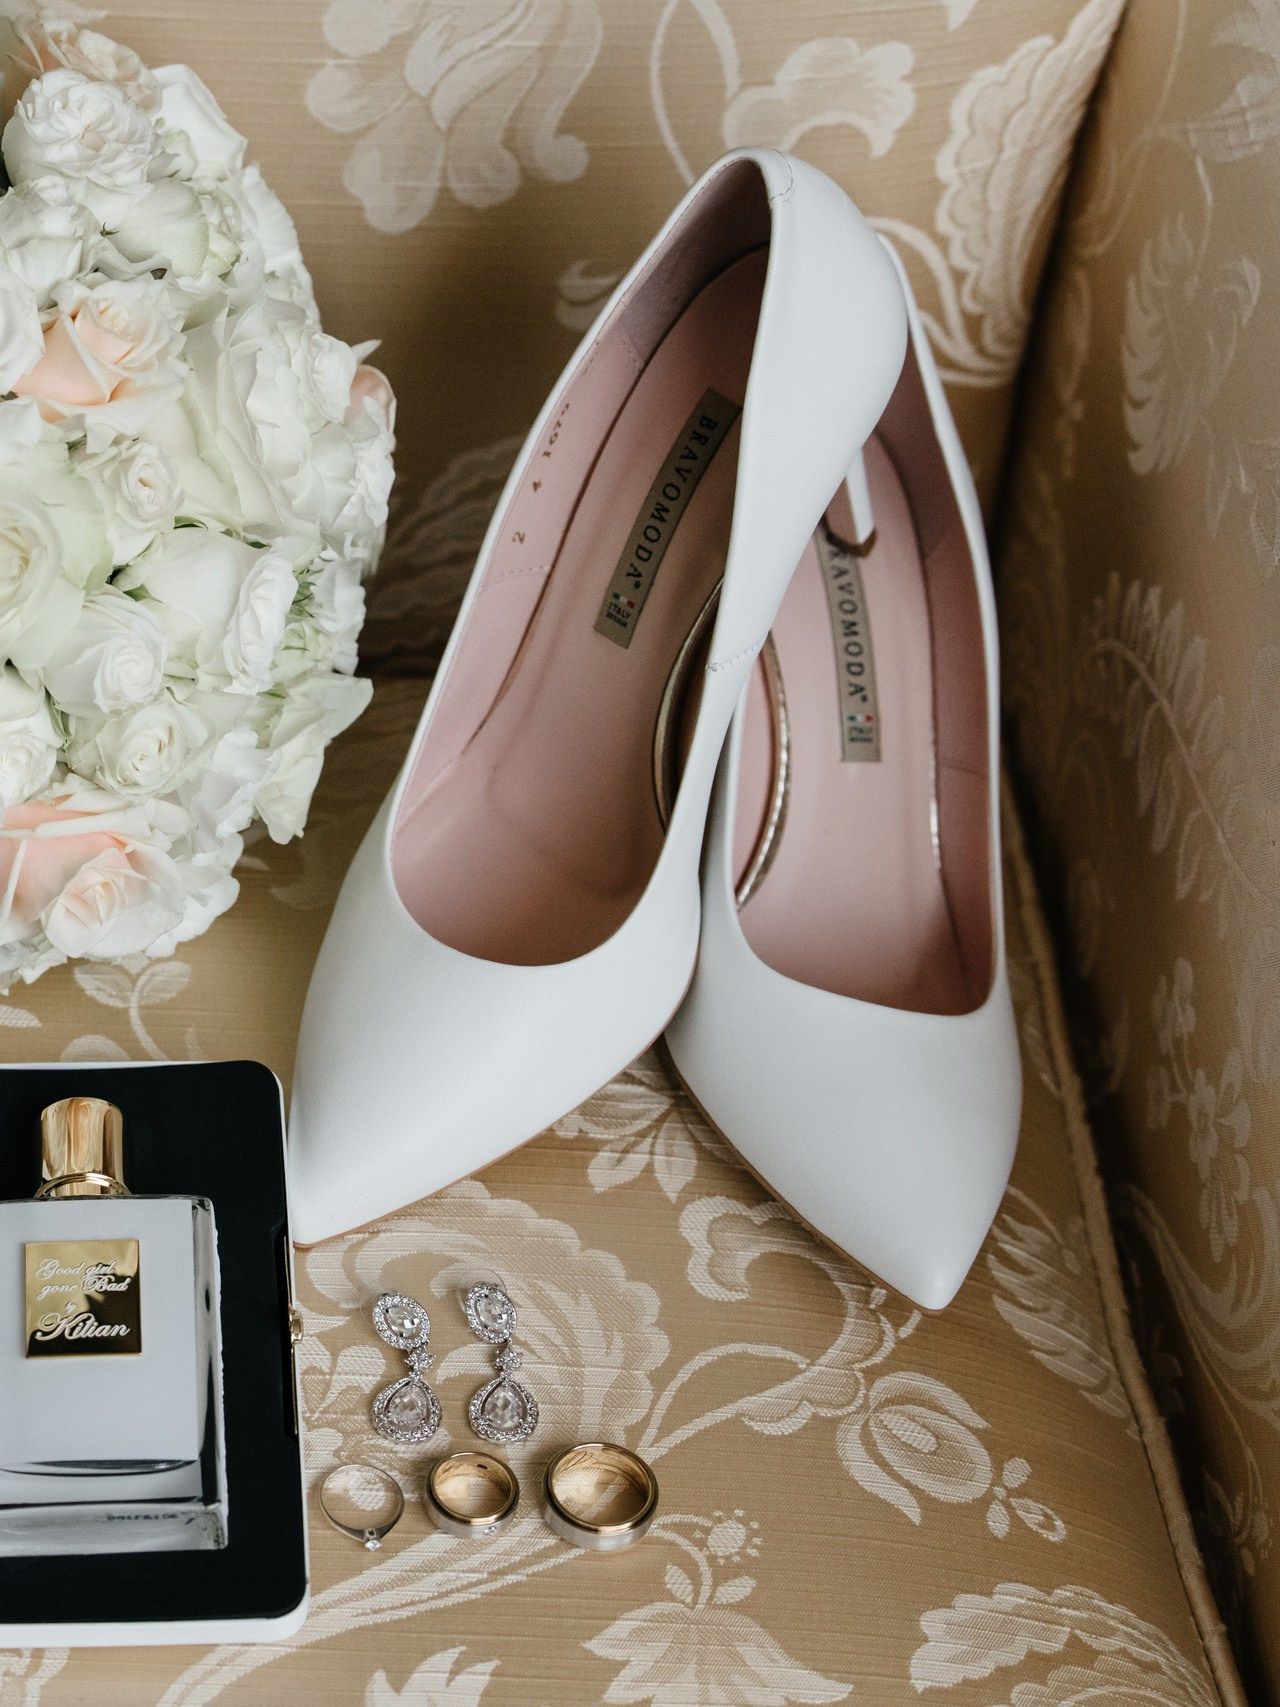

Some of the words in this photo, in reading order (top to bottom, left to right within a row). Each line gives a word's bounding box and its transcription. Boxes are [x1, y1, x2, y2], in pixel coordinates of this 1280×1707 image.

[626, 414, 719, 584] BRAVOMODA
[36, 1259, 85, 1280] Good
[81, 1260, 116, 1280] girl
[36, 1283, 78, 1300] gone
[82, 1275, 131, 1292] Bad
[65, 1301, 77, 1314] by
[35, 1312, 131, 1341] Kilian
